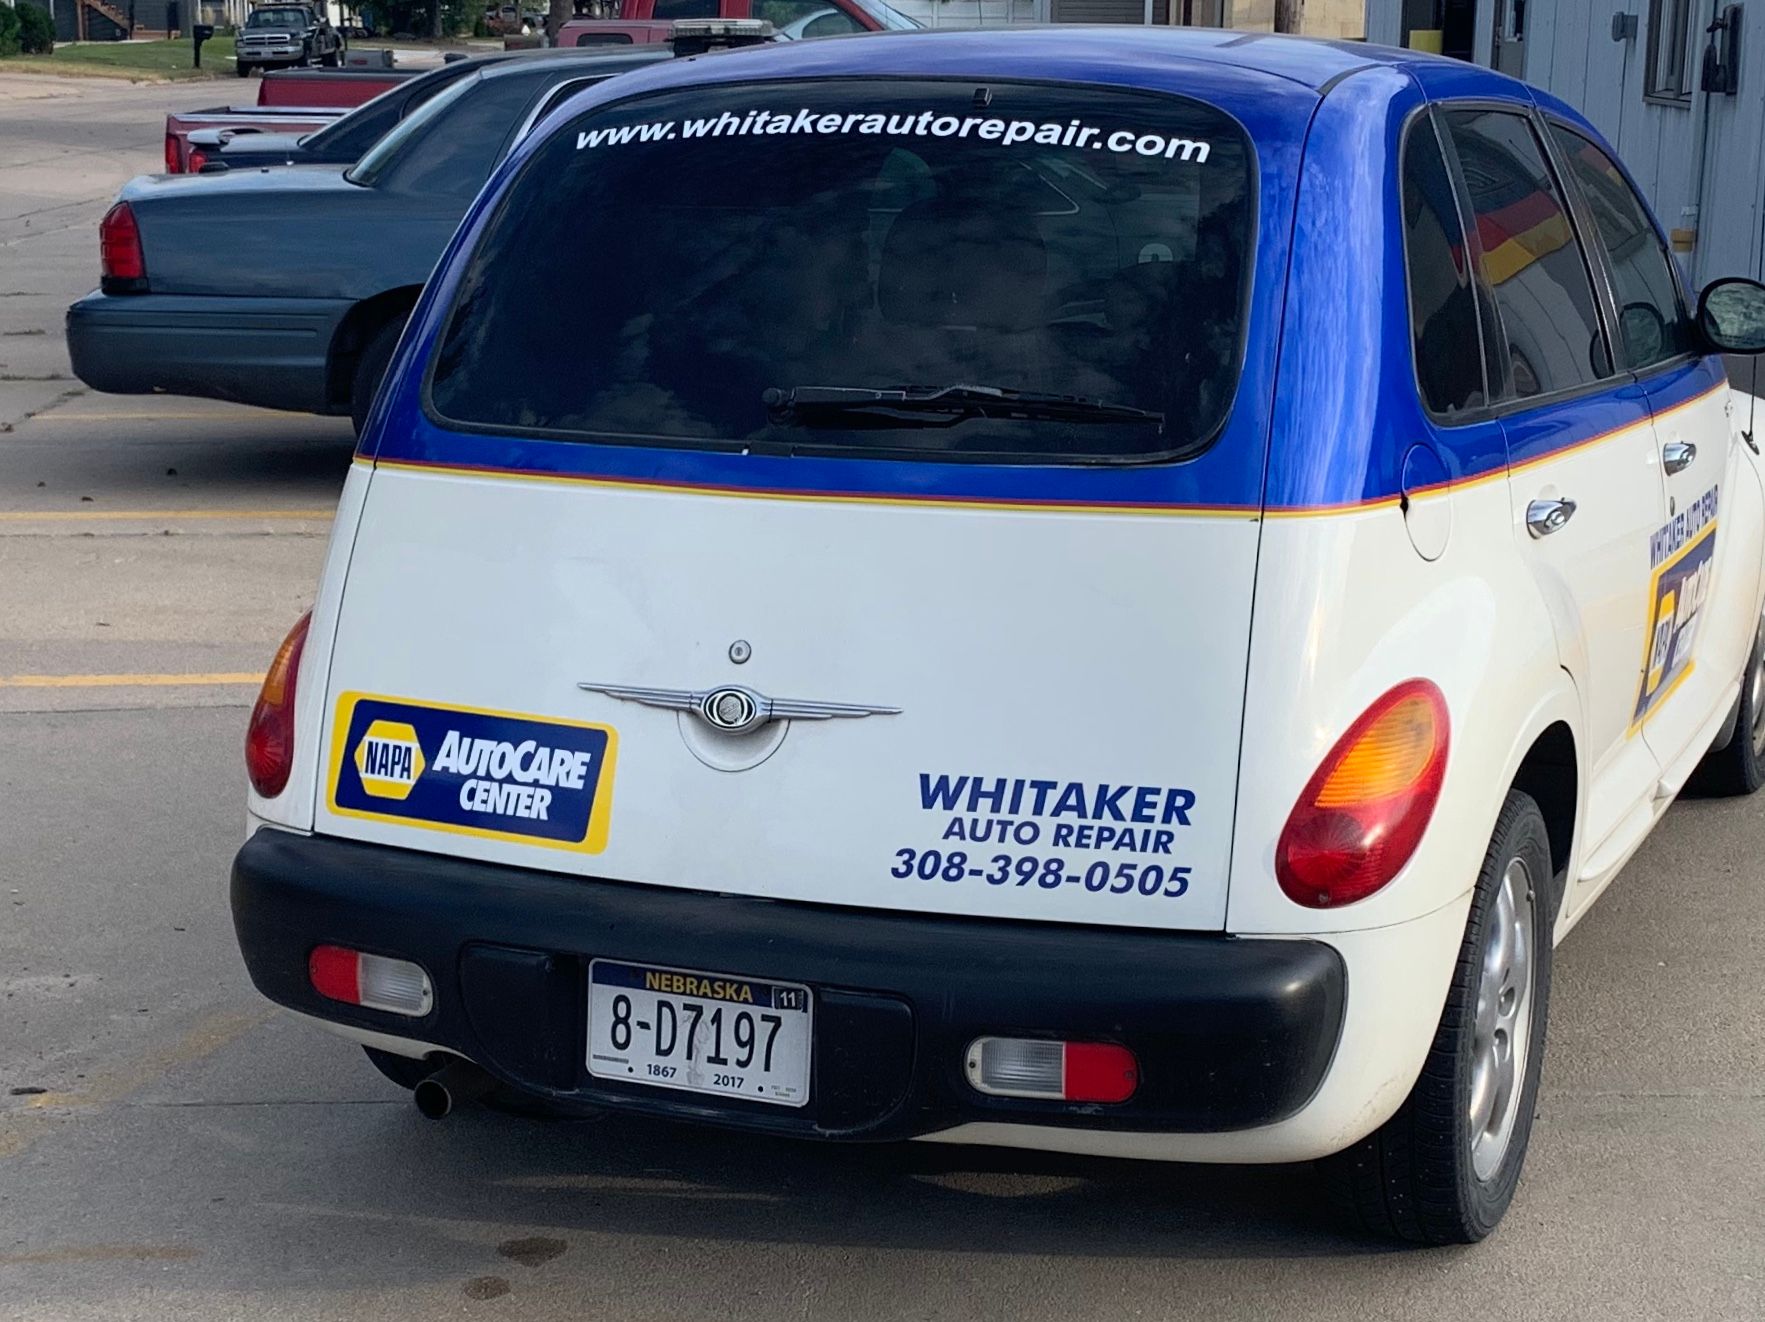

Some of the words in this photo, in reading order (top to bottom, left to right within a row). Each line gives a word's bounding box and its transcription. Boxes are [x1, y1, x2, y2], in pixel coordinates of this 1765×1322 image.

[576, 109, 1211, 164] www.whitakerautorepair.com
[364, 739, 413, 780] NAPA
[432, 729, 591, 789] AUTOCARE
[459, 778, 552, 820] CENTER
[919, 773, 1196, 826] WHITAKER
[942, 816, 1041, 845] AUTO
[1052, 823, 1175, 854] REPAIR
[891, 848, 1192, 898] 308-398-0505
[646, 971, 753, 1003] NEBRASKA
[780, 991, 796, 1007] 11
[611, 994, 782, 1072] 8-D7197
[646, 1063, 677, 1078] 1867
[713, 1074, 744, 1089] 2017
